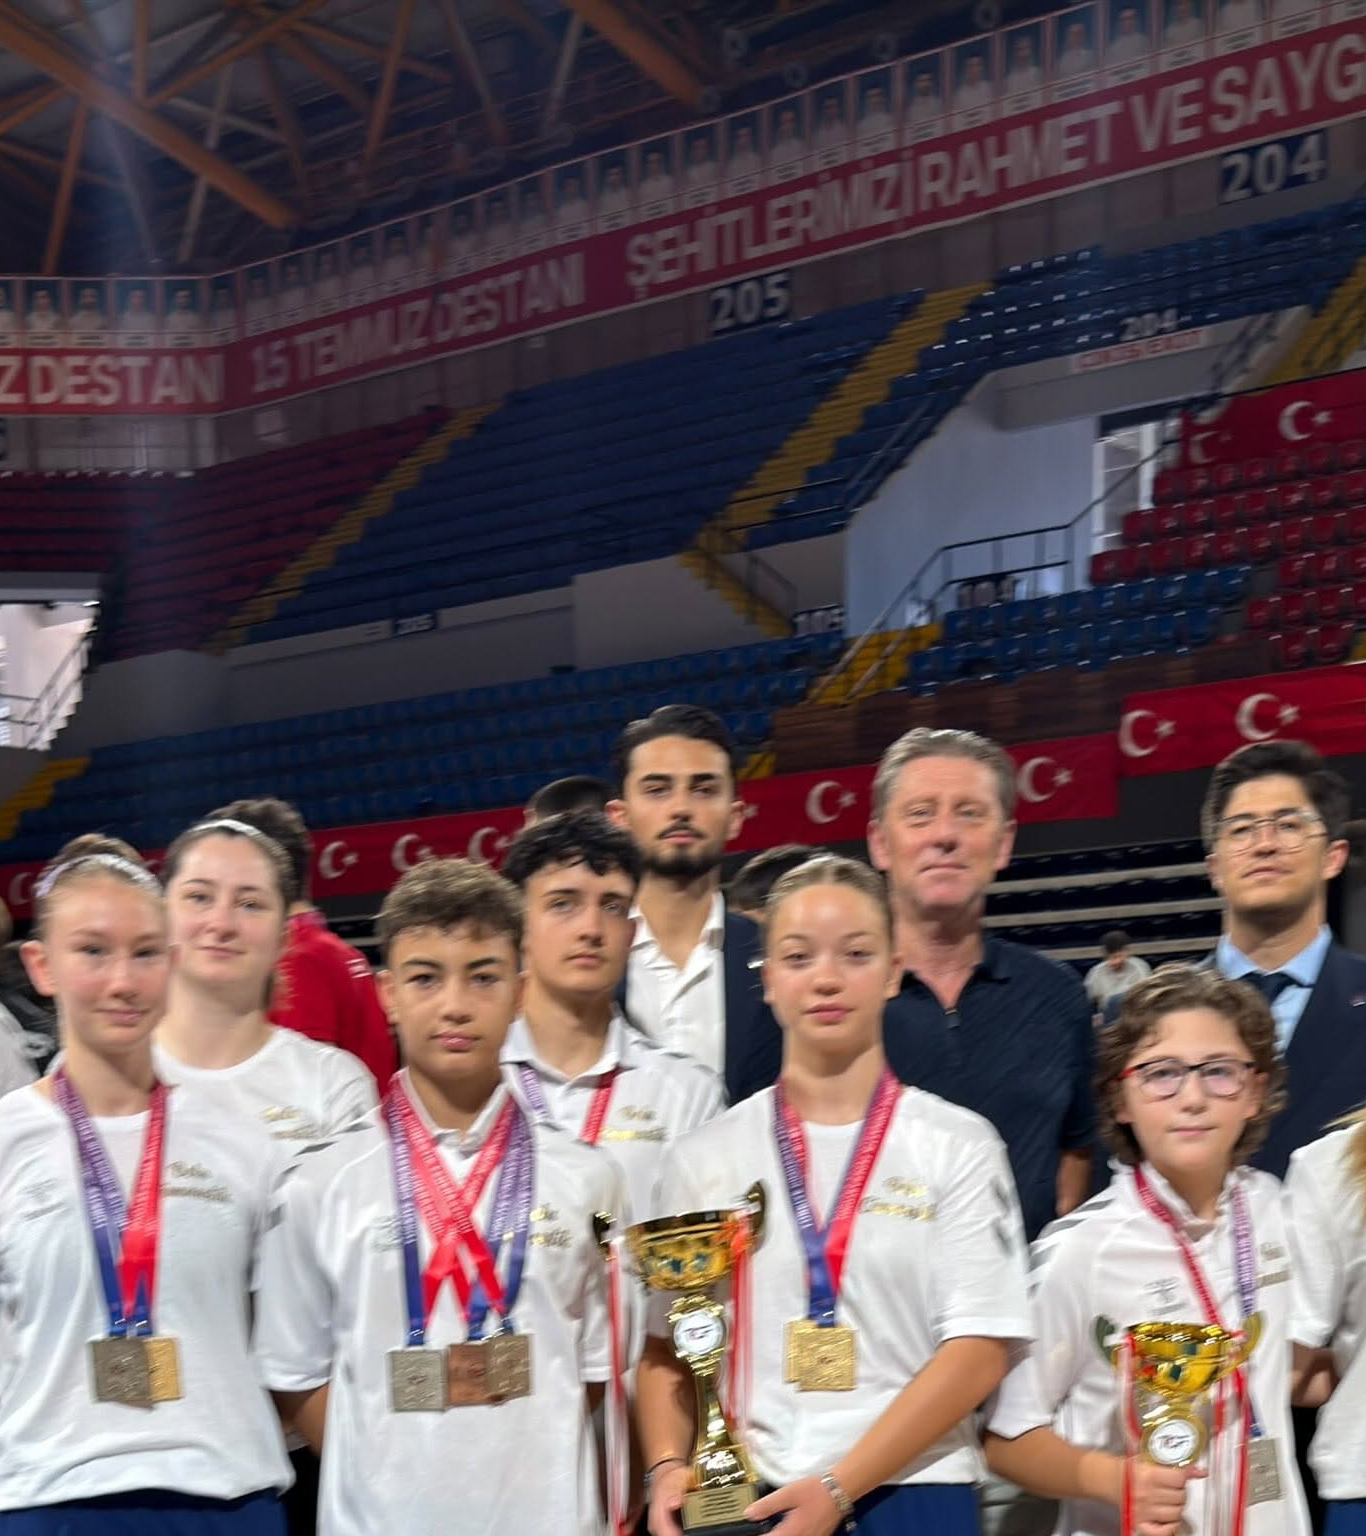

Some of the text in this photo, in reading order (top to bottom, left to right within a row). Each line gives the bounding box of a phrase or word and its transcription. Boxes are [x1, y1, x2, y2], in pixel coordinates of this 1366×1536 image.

[918, 100, 1124, 212] RAHMET
[1129, 77, 1204, 153] VE
[1223, 134, 1326, 196] 204
[714, 272, 791, 331] 205
[250, 341, 286, 394] 15
[293, 299, 433, 382] TEMMUZ
